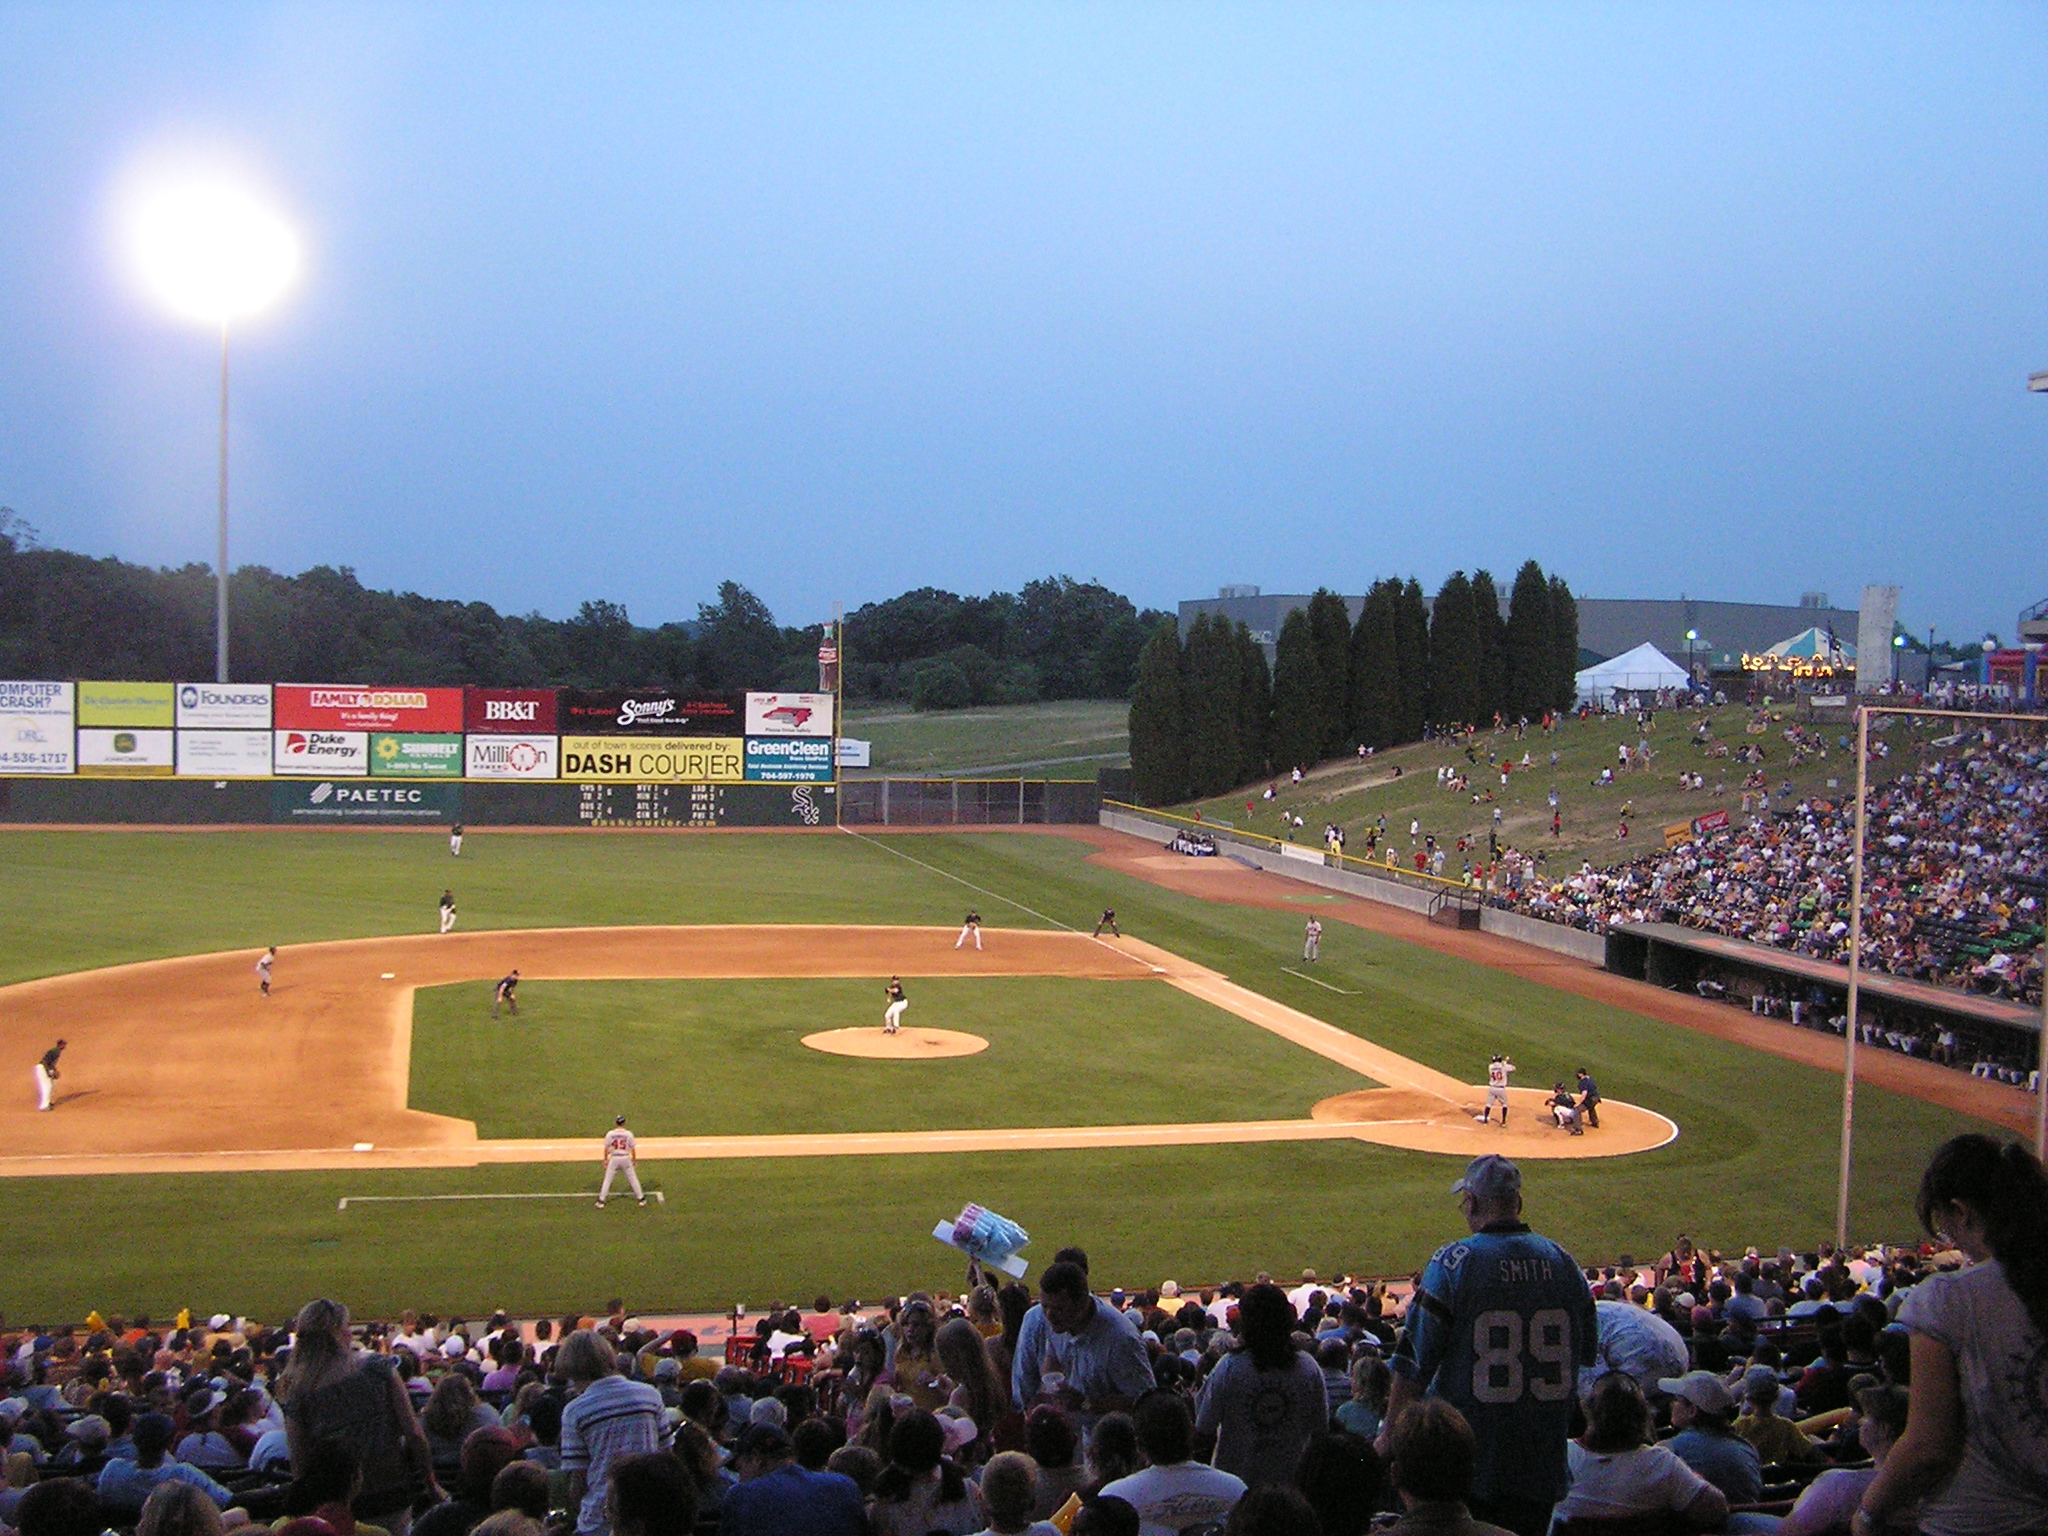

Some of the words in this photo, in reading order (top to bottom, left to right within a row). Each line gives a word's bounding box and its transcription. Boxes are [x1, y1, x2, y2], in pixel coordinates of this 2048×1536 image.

[0, 683, 62, 696] OMPUTER
[0, 696, 52, 708] CRASH?
[201, 690, 269, 705] FOUNDERS
[312, 693, 358, 705] FAMILY
[373, 694, 427, 707] DOLLAR
[486, 701, 540, 720] BB&T
[616, 699, 676, 726] Sonny's
[310, 733, 346, 744] Duke
[307, 744, 358, 757] Energy
[573, 741, 590, 750] out
[592, 740, 602, 750] of
[604, 741, 628, 750] town
[630, 742, 663, 750] scores
[665, 741, 713, 751] delivered
[715, 742, 731, 753] by:
[566, 754, 632, 774] DASH
[639, 754, 740, 775] COURIER
[336, 789, 421, 803] PAETEC
[611, 1139, 627, 1150] 45
[1500, 1258, 1552, 1282] SMITH
[1472, 1308, 1573, 1404] 89
